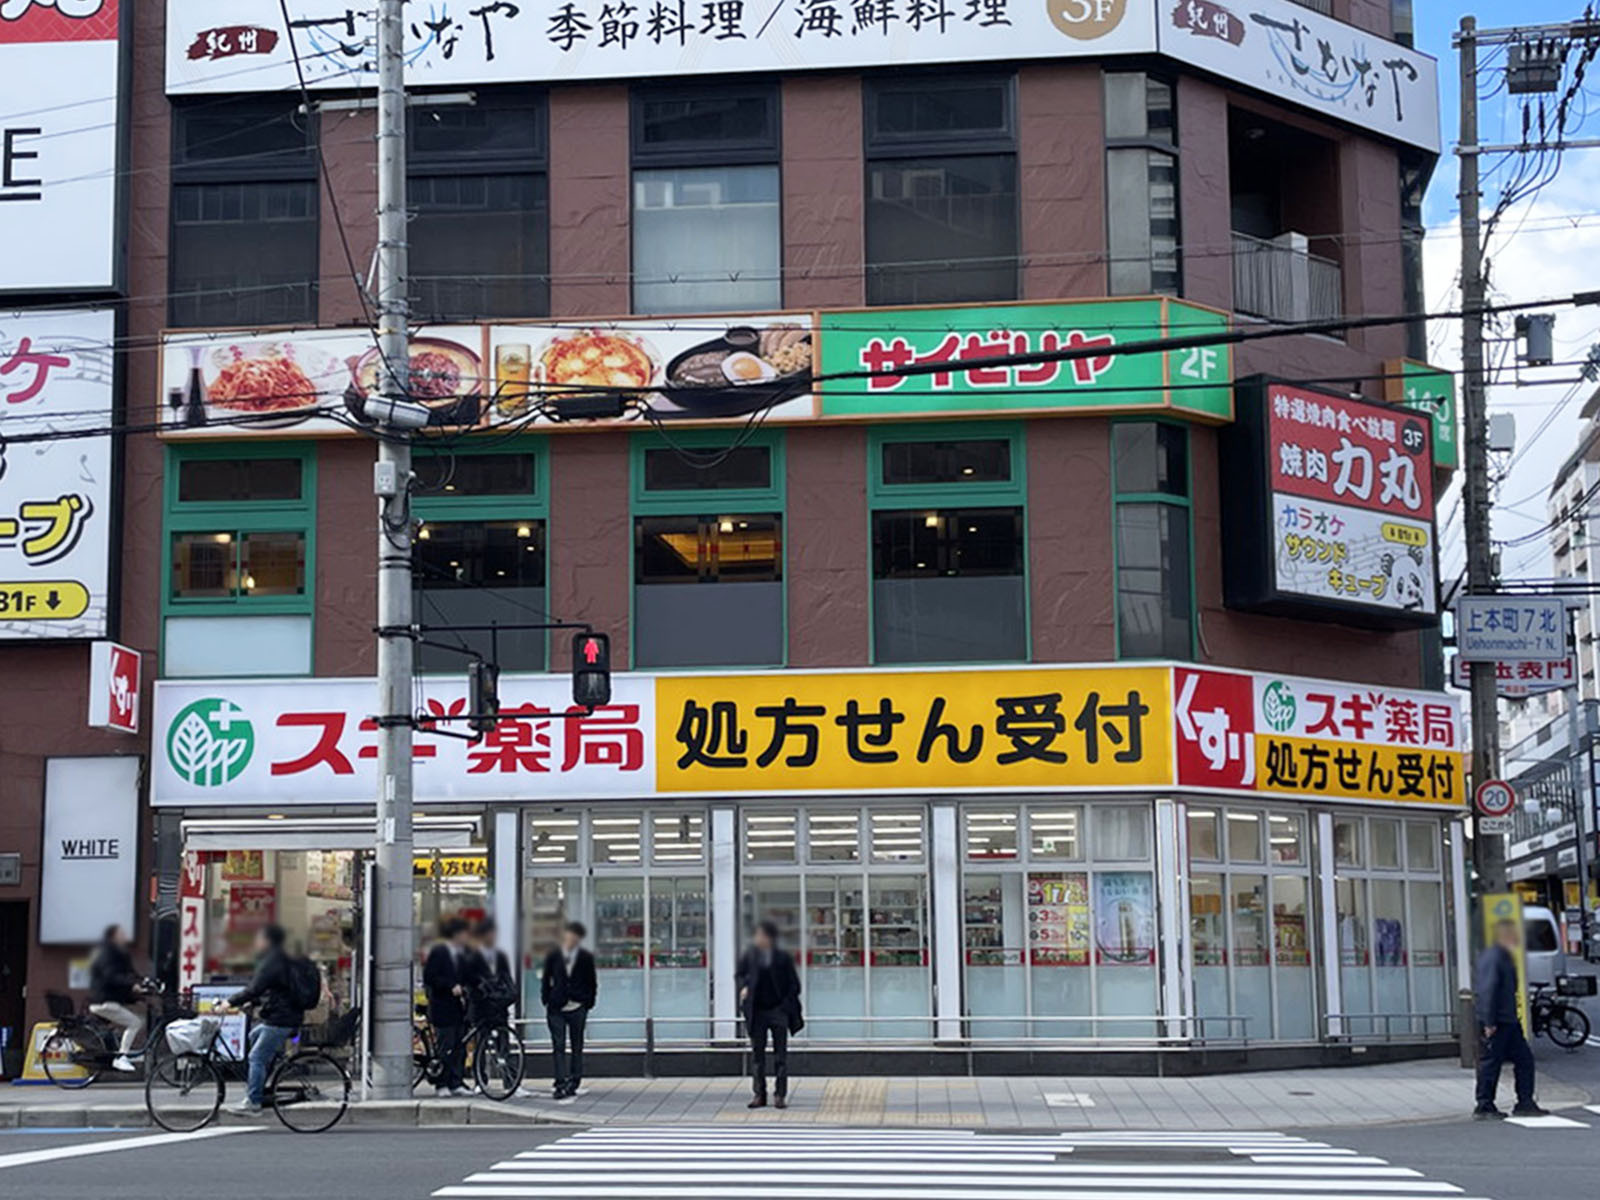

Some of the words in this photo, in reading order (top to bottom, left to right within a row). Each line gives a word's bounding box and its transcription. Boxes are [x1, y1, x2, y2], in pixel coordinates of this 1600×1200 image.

[289, 1, 520, 62] さなや
[1187, 1, 1230, 39] 紀州
[205, 31, 258, 55] 紀州
[861, 331, 1116, 390] サイゼリヤ
[1179, 348, 1217, 379] 2F
[1403, 429, 1423, 447] 3F
[1282, 505, 1345, 536] カラオケ
[1285, 532, 1349, 565] サウンド
[1467, 608, 1556, 633] 上本町7北
[110, 651, 138, 727] くすり
[270, 697, 645, 775] スギ薬局
[675, 690, 1150, 770] 処方せん受付
[1176, 674, 1257, 786] くすり
[1305, 692, 1455, 748] スギ薬局
[1265, 739, 1454, 800] 処方せん受付
[1485, 790, 1508, 806] 20
[61, 839, 119, 855] WHITE
